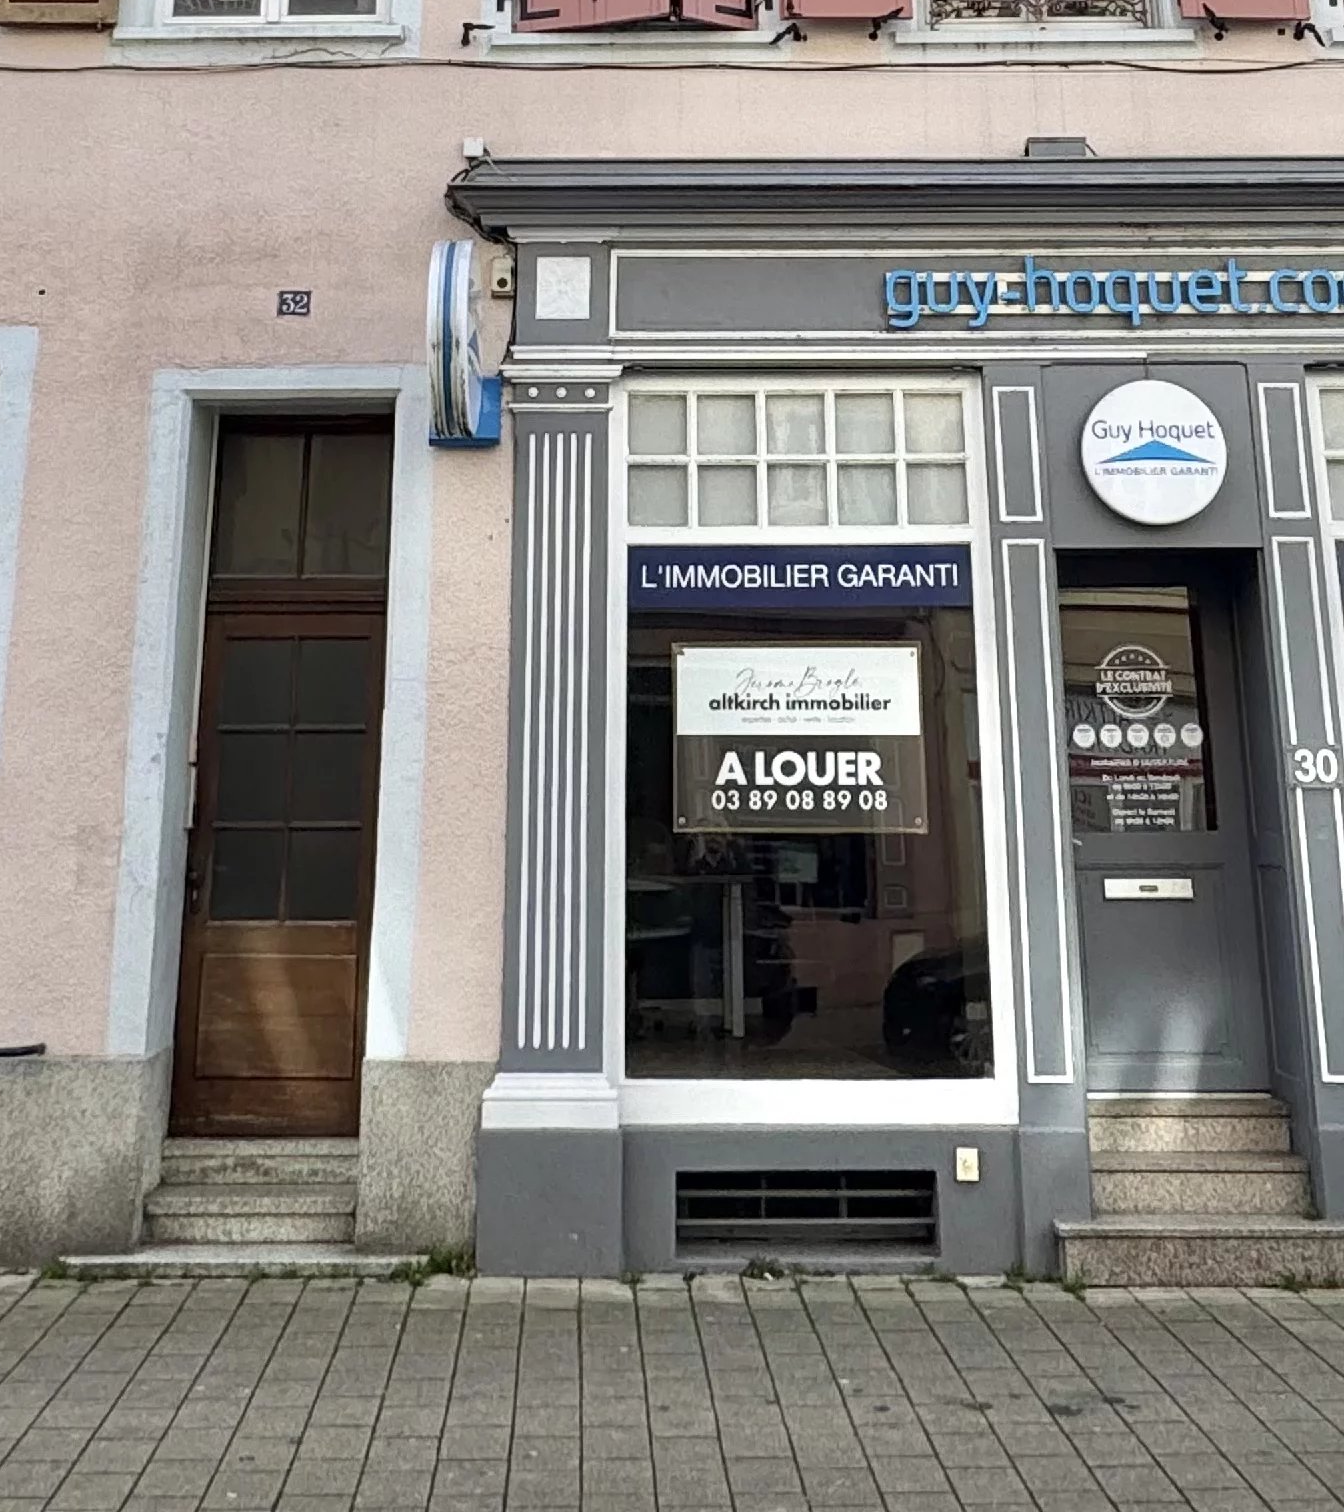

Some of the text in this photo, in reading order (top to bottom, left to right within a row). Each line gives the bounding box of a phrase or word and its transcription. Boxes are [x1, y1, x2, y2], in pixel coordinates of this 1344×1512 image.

[282, 293, 308, 314] 32
[1091, 419, 1216, 444] Guy Hoquet
[641, 563, 958, 588] L'IMMOBILIER GARANTI
[709, 693, 891, 711] altkirch immobilier
[715, 751, 884, 786] A LOUER
[1294, 748, 1338, 783] 30
[711, 790, 888, 811] 03 89 08 89 08
